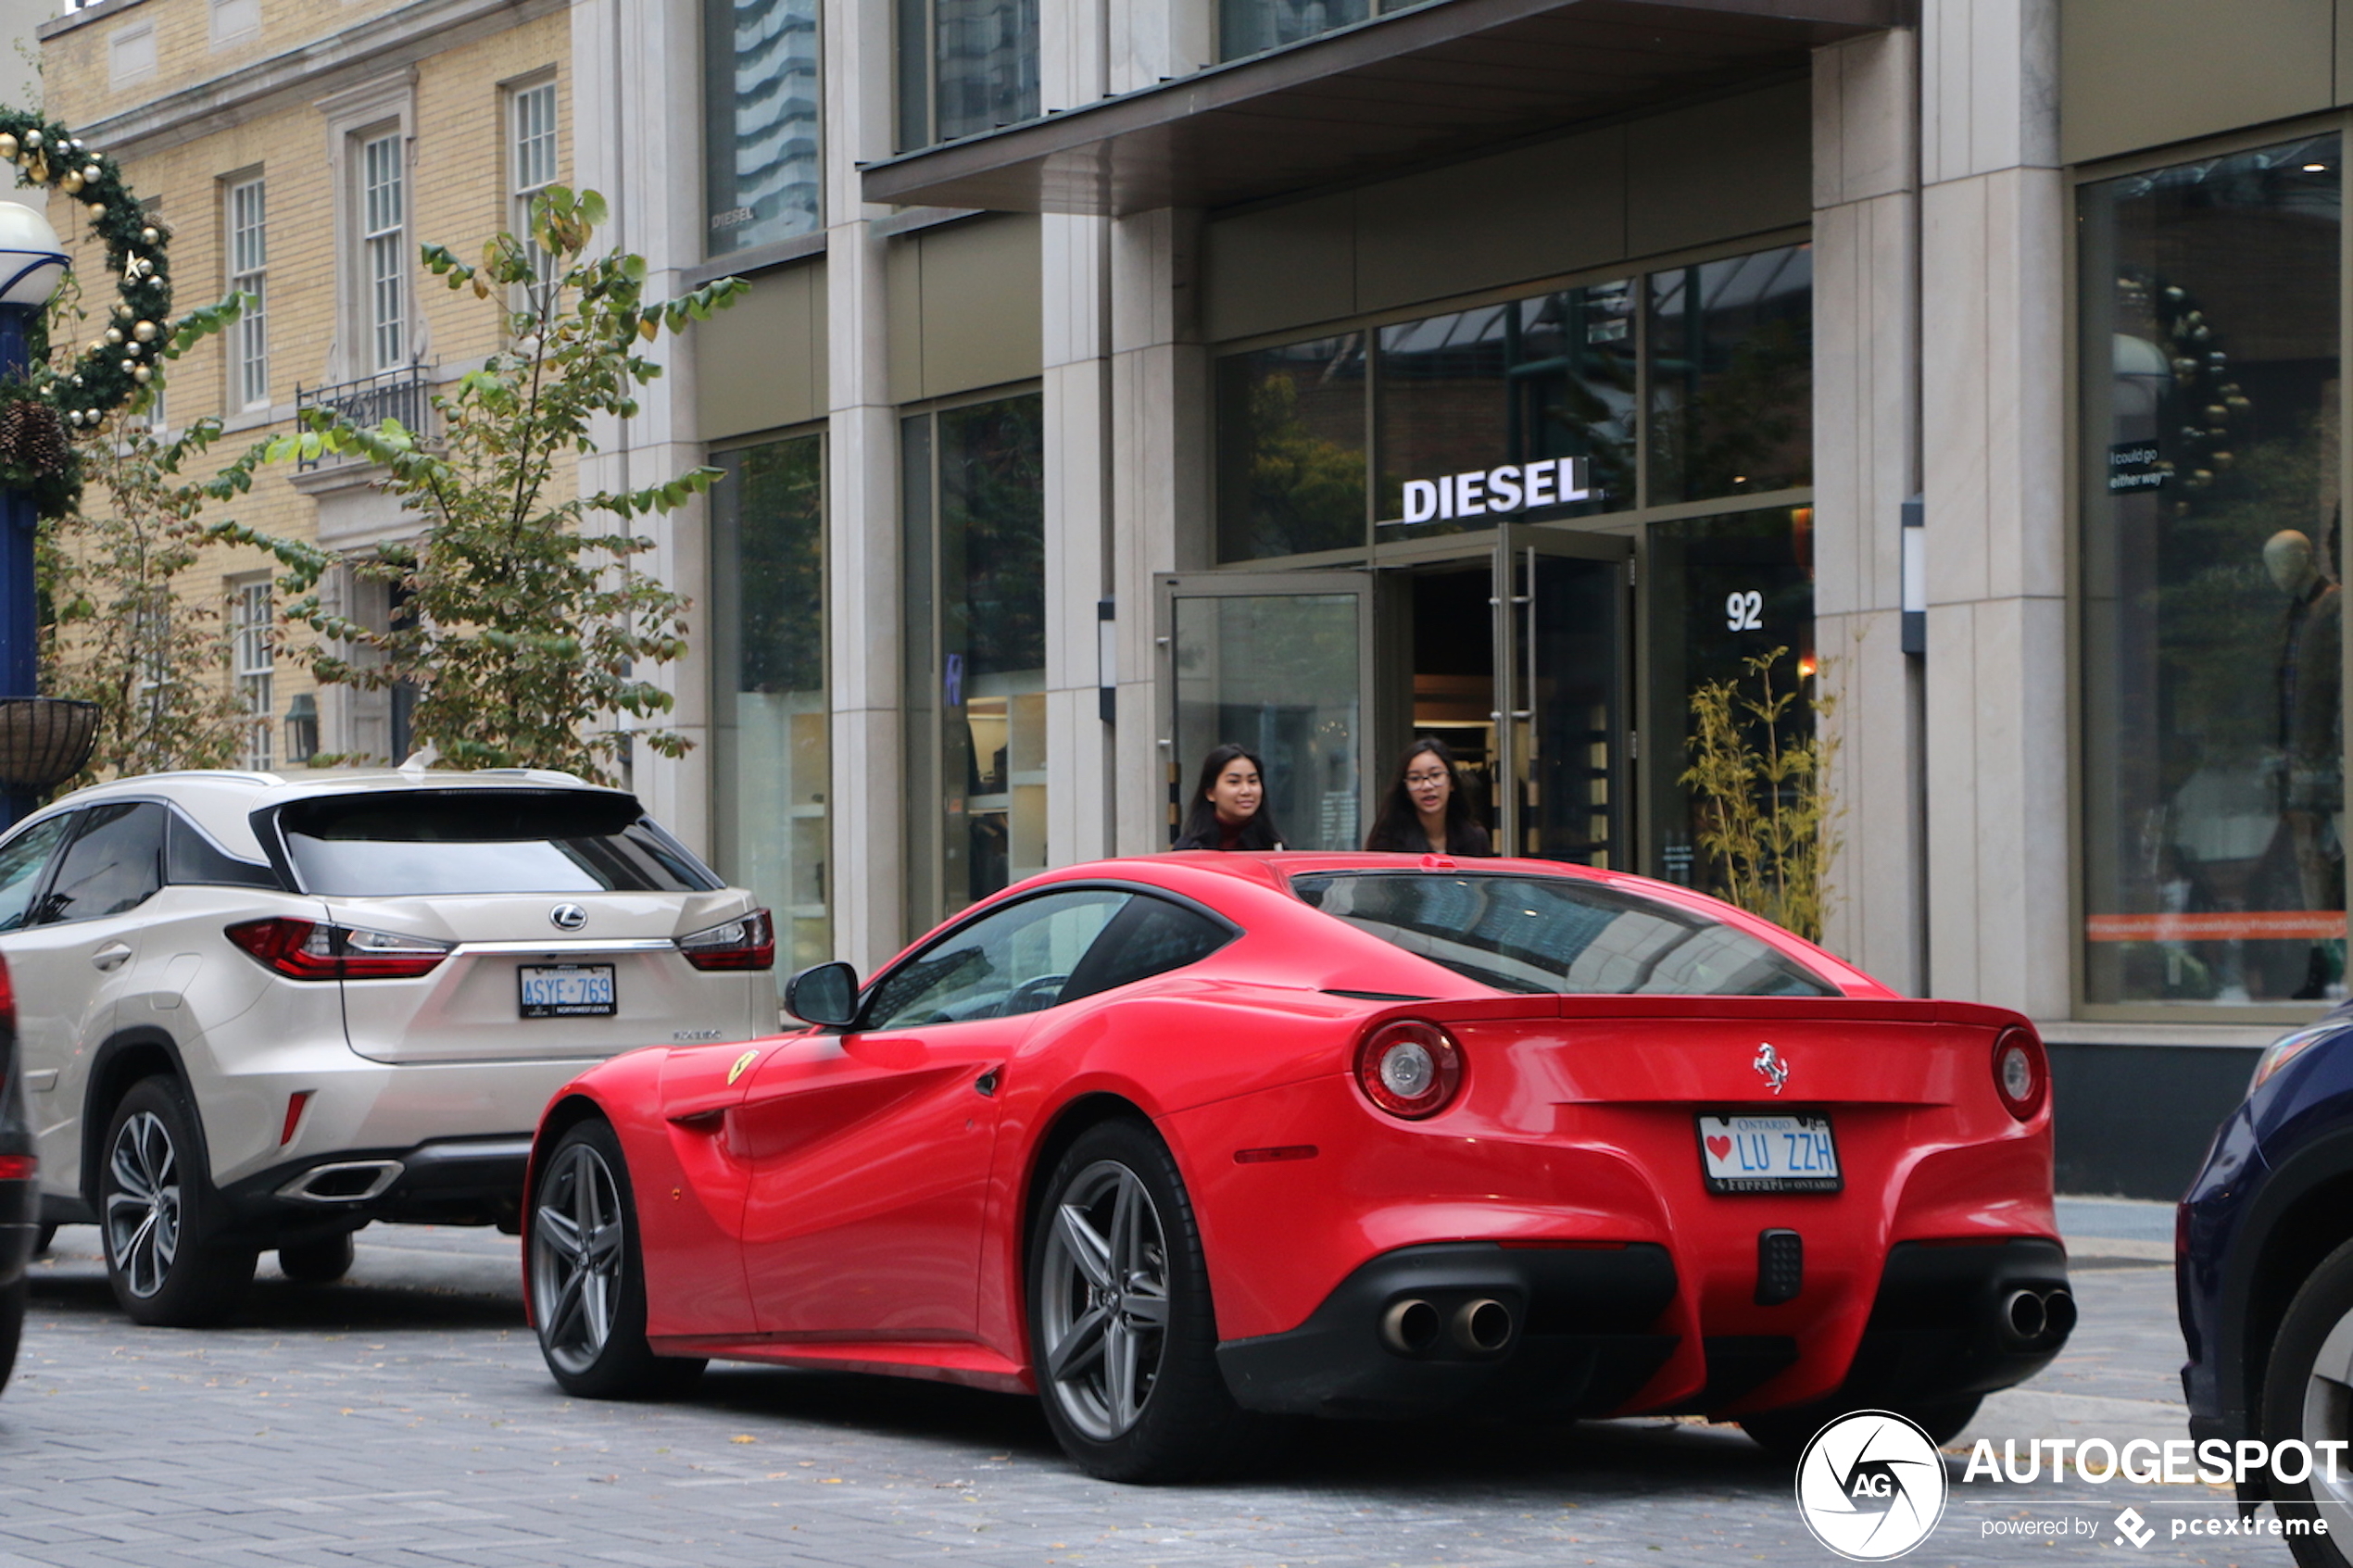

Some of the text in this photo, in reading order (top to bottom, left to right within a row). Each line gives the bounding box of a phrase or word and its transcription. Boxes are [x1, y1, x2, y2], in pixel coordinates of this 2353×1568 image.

[711, 206, 754, 229] DIESEL
[2116, 448, 2143, 465] could
[2144, 448, 2158, 464] go
[1403, 457, 1590, 524] DIESEL
[2110, 473, 2141, 488] either
[1726, 590, 1763, 632] 92
[524, 977, 610, 1005] ASYE 769
[1738, 1118, 1792, 1131] ONTARIO
[1736, 1133, 1833, 1171] LU ZZH
[1729, 1179, 1784, 1191] Ferrari
[1793, 1180, 1838, 1190] ONTARIO
